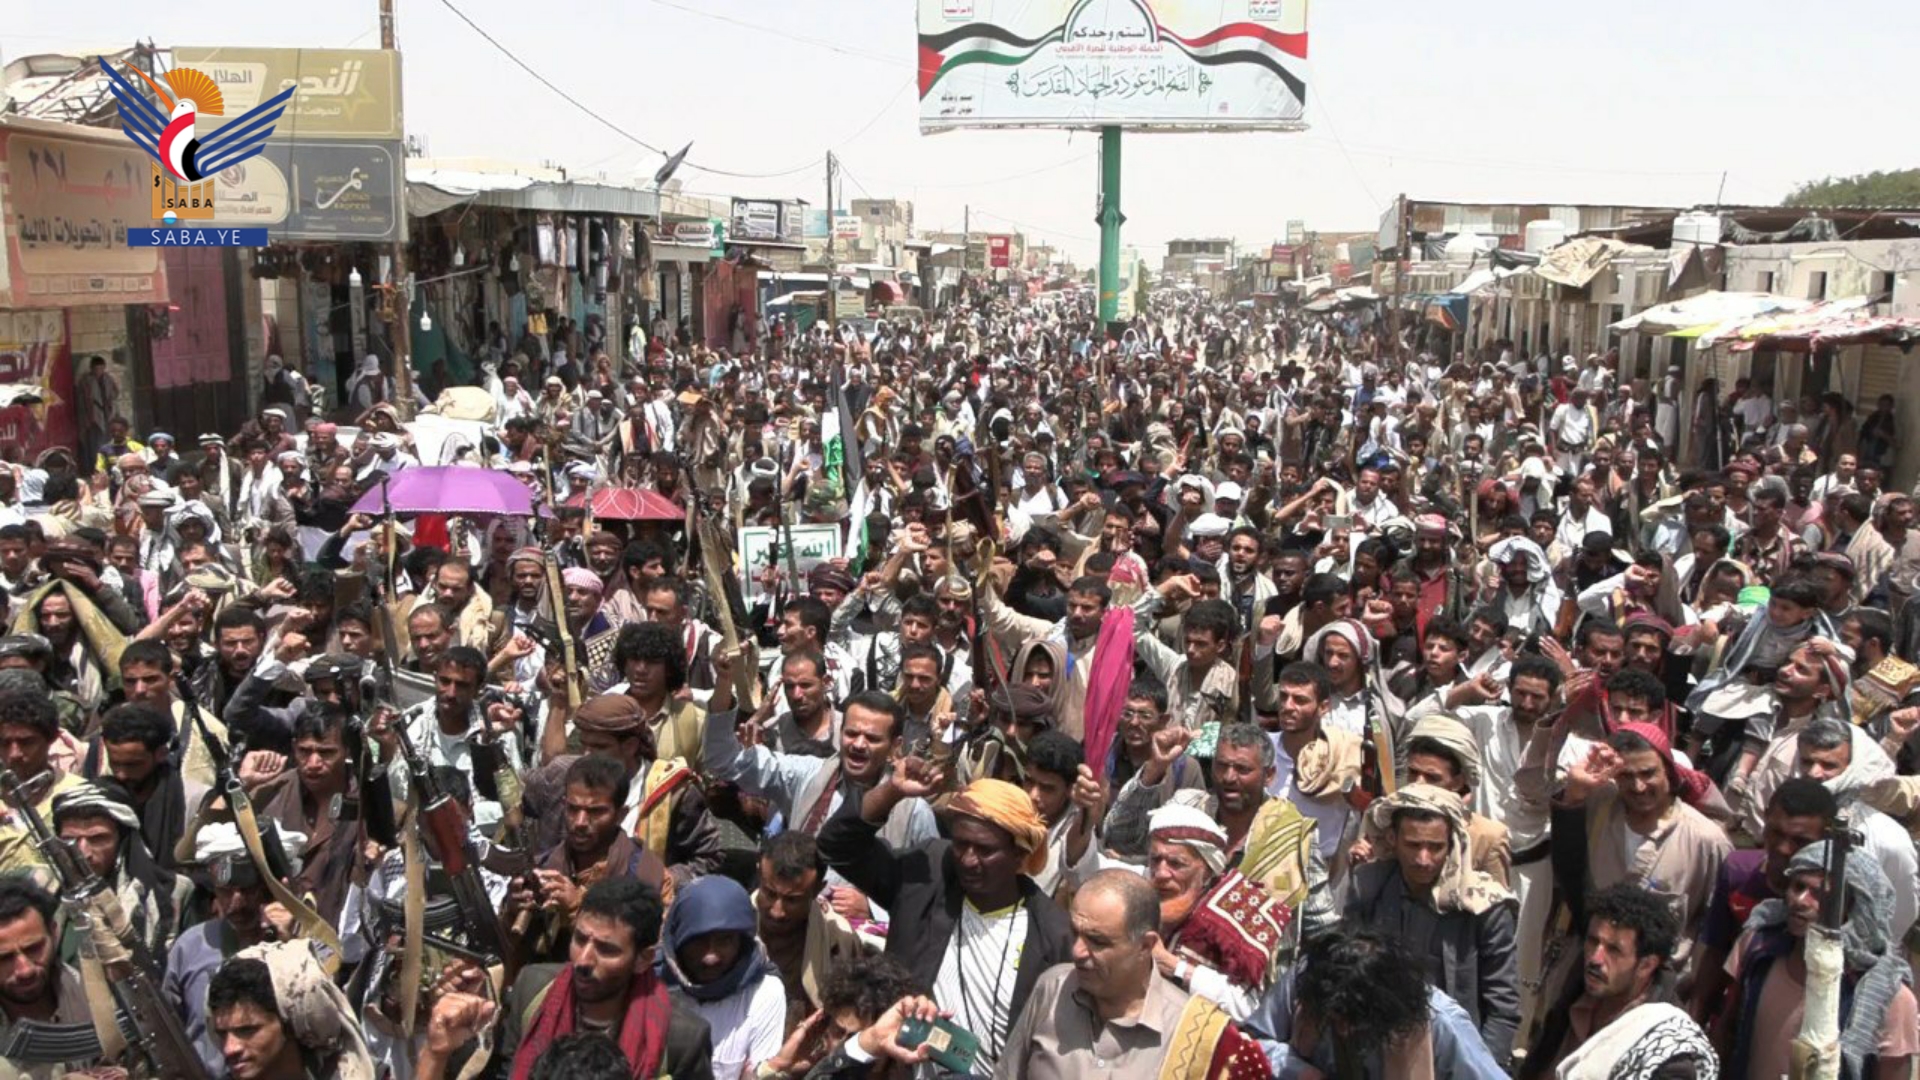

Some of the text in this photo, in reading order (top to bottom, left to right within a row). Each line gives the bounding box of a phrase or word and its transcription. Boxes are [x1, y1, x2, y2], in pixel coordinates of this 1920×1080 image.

[1073, 25, 1147, 40] لستم وحدكم
[751, 537, 831, 568] الله كبر
